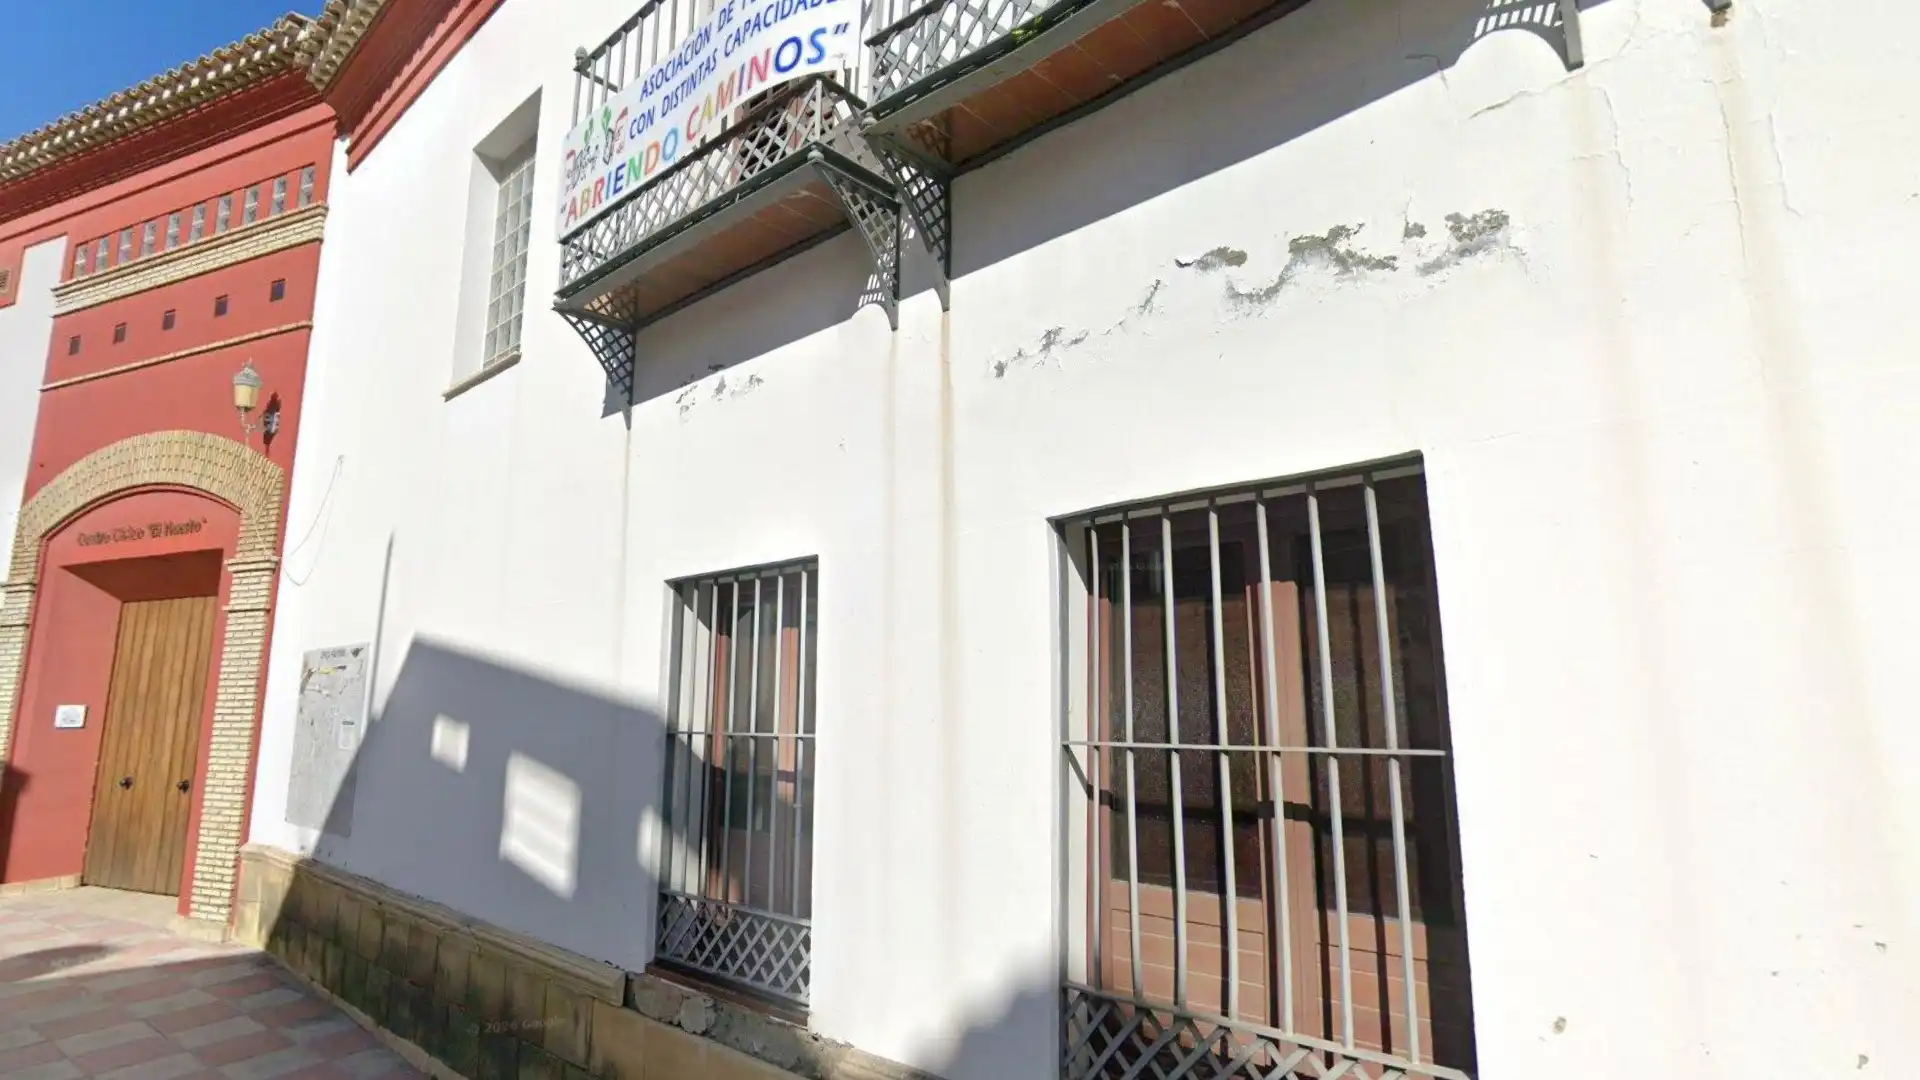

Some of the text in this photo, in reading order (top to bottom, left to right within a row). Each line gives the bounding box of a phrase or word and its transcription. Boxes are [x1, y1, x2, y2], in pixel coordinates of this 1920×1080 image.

[717, 0, 736, 32] DE
[629, 104, 656, 140] CON
[661, 47, 718, 118] DISTINTAS
